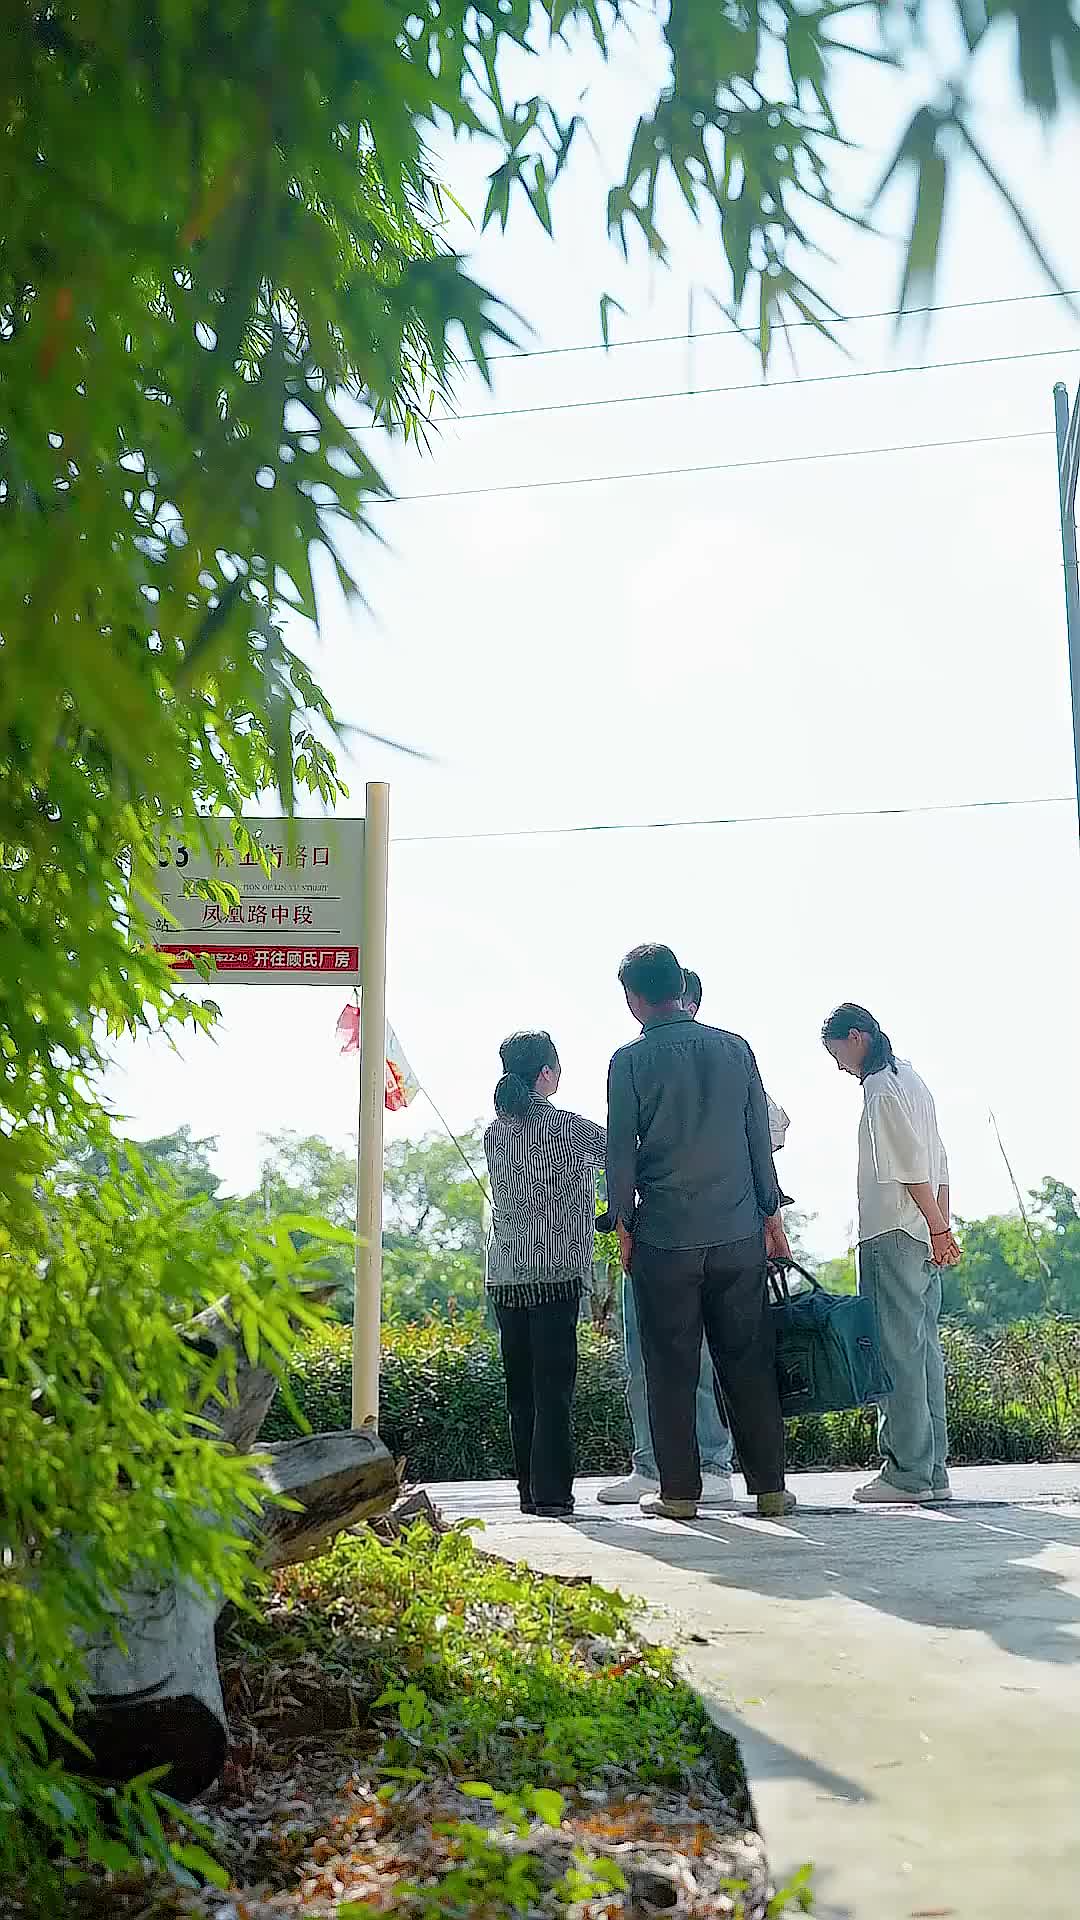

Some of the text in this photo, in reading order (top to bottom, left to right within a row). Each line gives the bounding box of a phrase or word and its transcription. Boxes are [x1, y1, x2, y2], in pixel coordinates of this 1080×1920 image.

[202, 904, 313, 925] 凤凰路中段
[254, 951, 351, 968] 开往顾氏厂房
